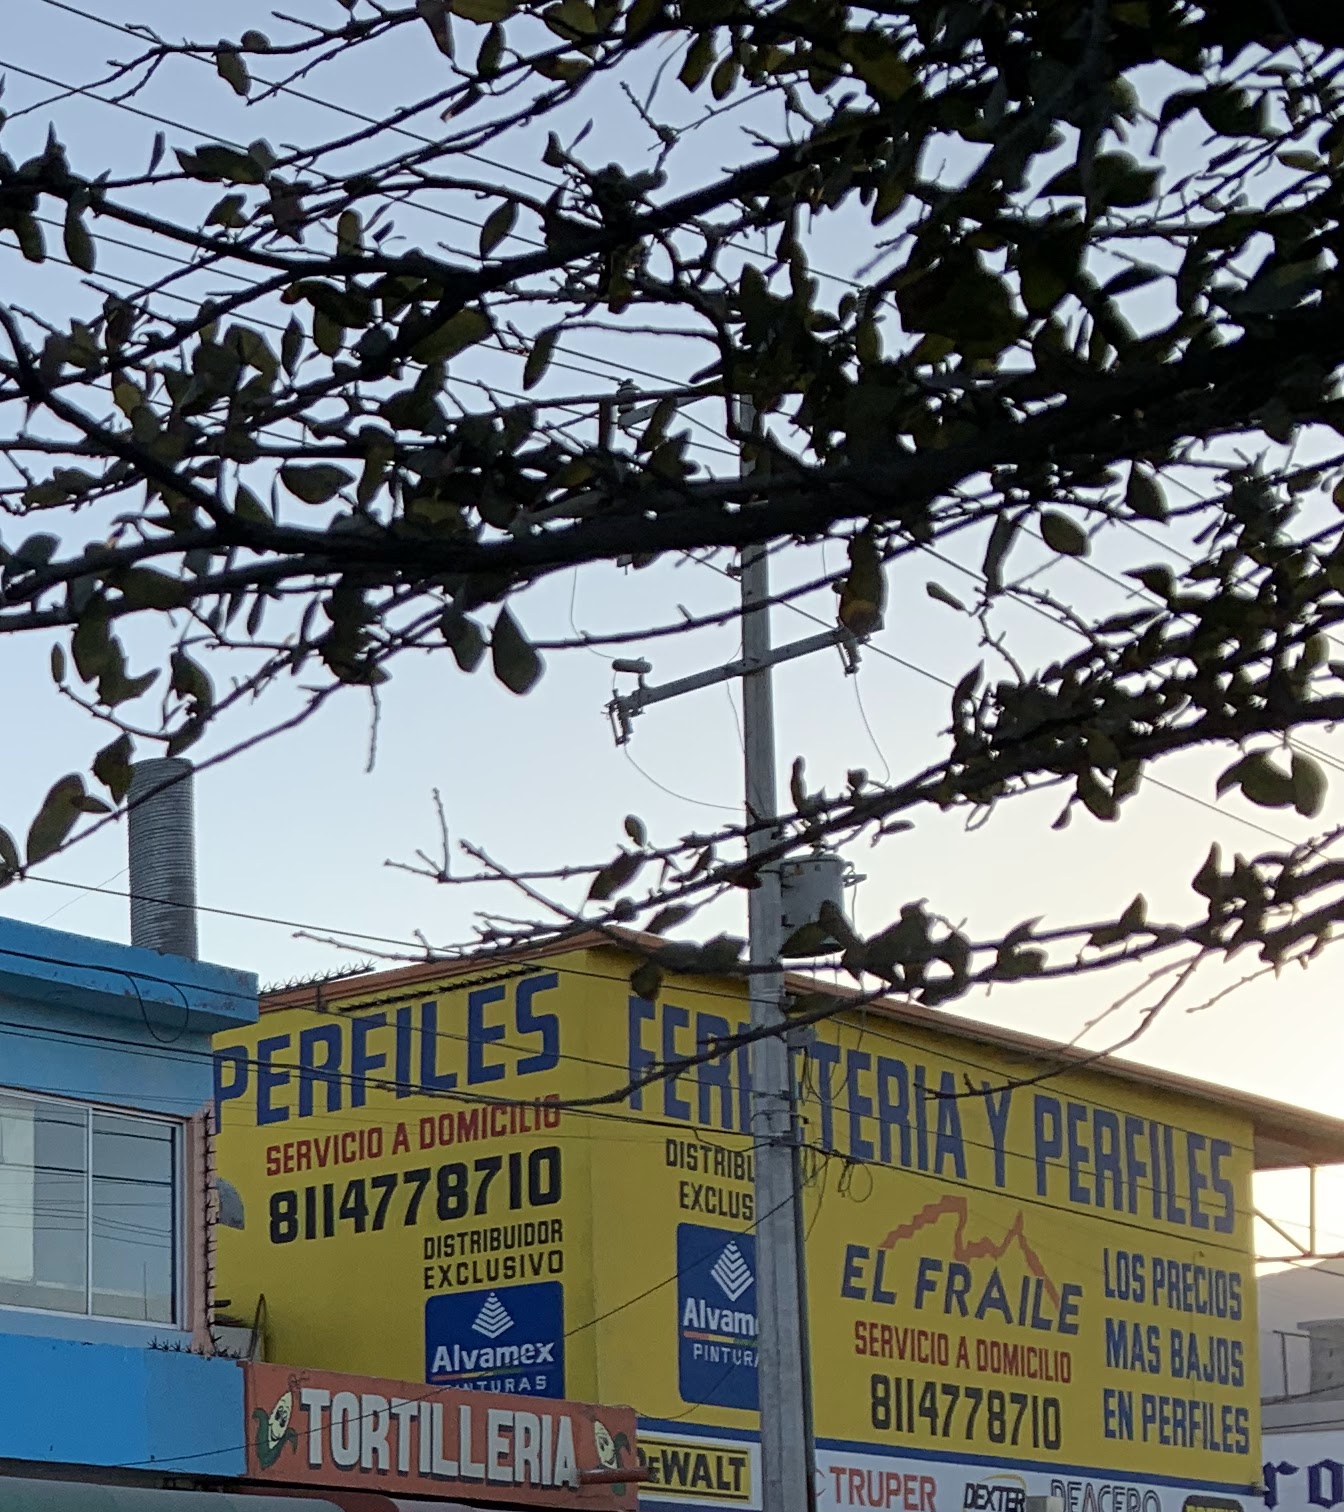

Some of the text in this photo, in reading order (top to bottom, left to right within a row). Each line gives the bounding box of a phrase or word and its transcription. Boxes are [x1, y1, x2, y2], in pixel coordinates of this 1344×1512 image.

[213, 972, 560, 1135] PERFILES
[266, 1094, 562, 1176] SERVICIO A DOMICILIO
[982, 1080, 1012, 1188] Y
[1033, 1092, 1235, 1235] PERFILES
[268, 1145, 563, 1245] 8114778710
[423, 1219, 564, 1261] DISTRIBUIDOR
[423, 1249, 564, 1290] EXCLUSIVO
[840, 1244, 1083, 1335] EL FRAILE
[1104, 1248, 1243, 1321] LOS PRECIOS
[431, 1339, 556, 1374] Alvamex
[854, 1320, 1072, 1385] SERVICIO A DOMICILIO
[1105, 1317, 1244, 1388] MAS BAJOS
[301, 1388, 581, 1489] TORTILLERIA
[871, 1374, 1062, 1451] 8114778710
[1103, 1388, 1250, 1456] EN PERFILES
[829, 1465, 937, 1512] TRUPER
